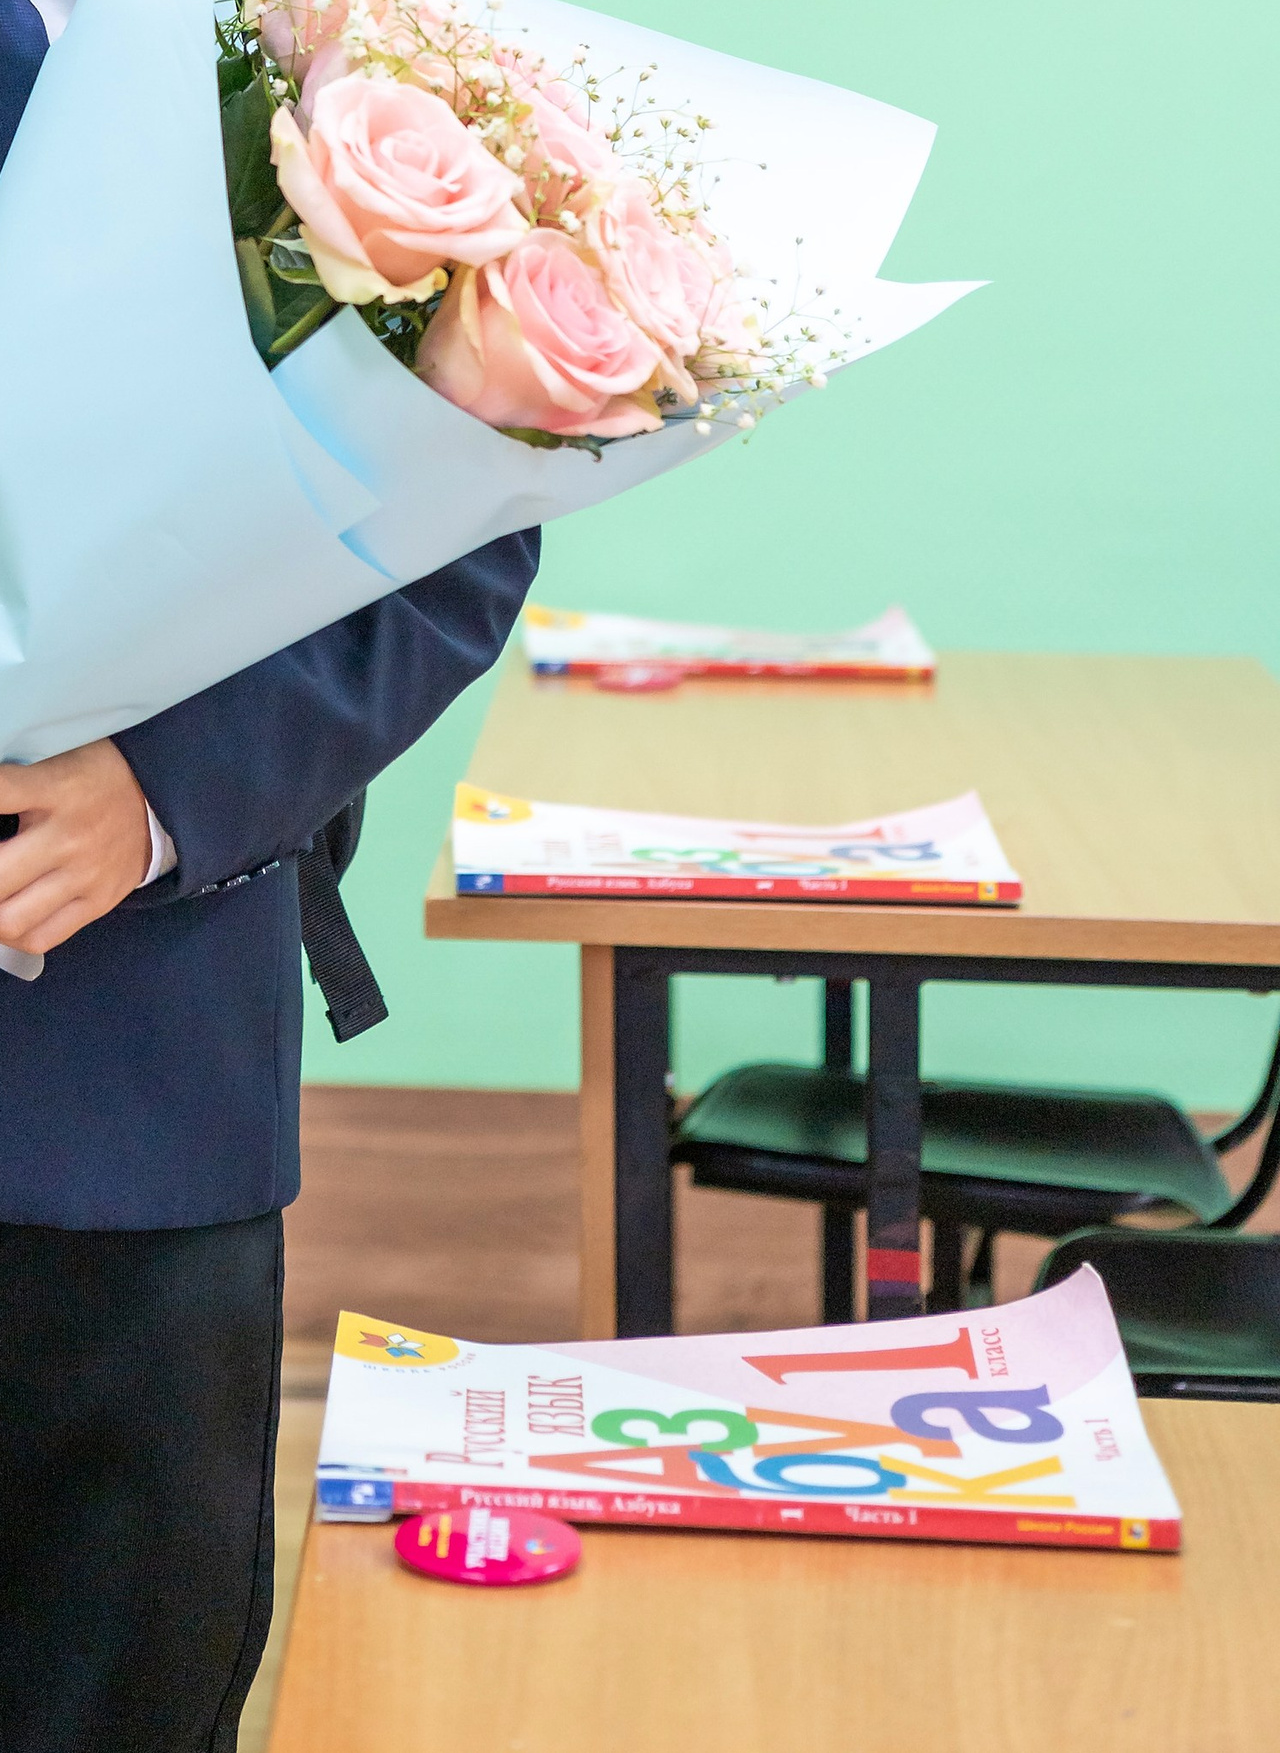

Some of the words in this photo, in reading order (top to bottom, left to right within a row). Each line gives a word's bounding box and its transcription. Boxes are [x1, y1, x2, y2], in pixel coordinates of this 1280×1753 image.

[741, 1327, 978, 1385] 1
[981, 1327, 1009, 1378] класс
[425, 1388, 523, 1468] Русский
